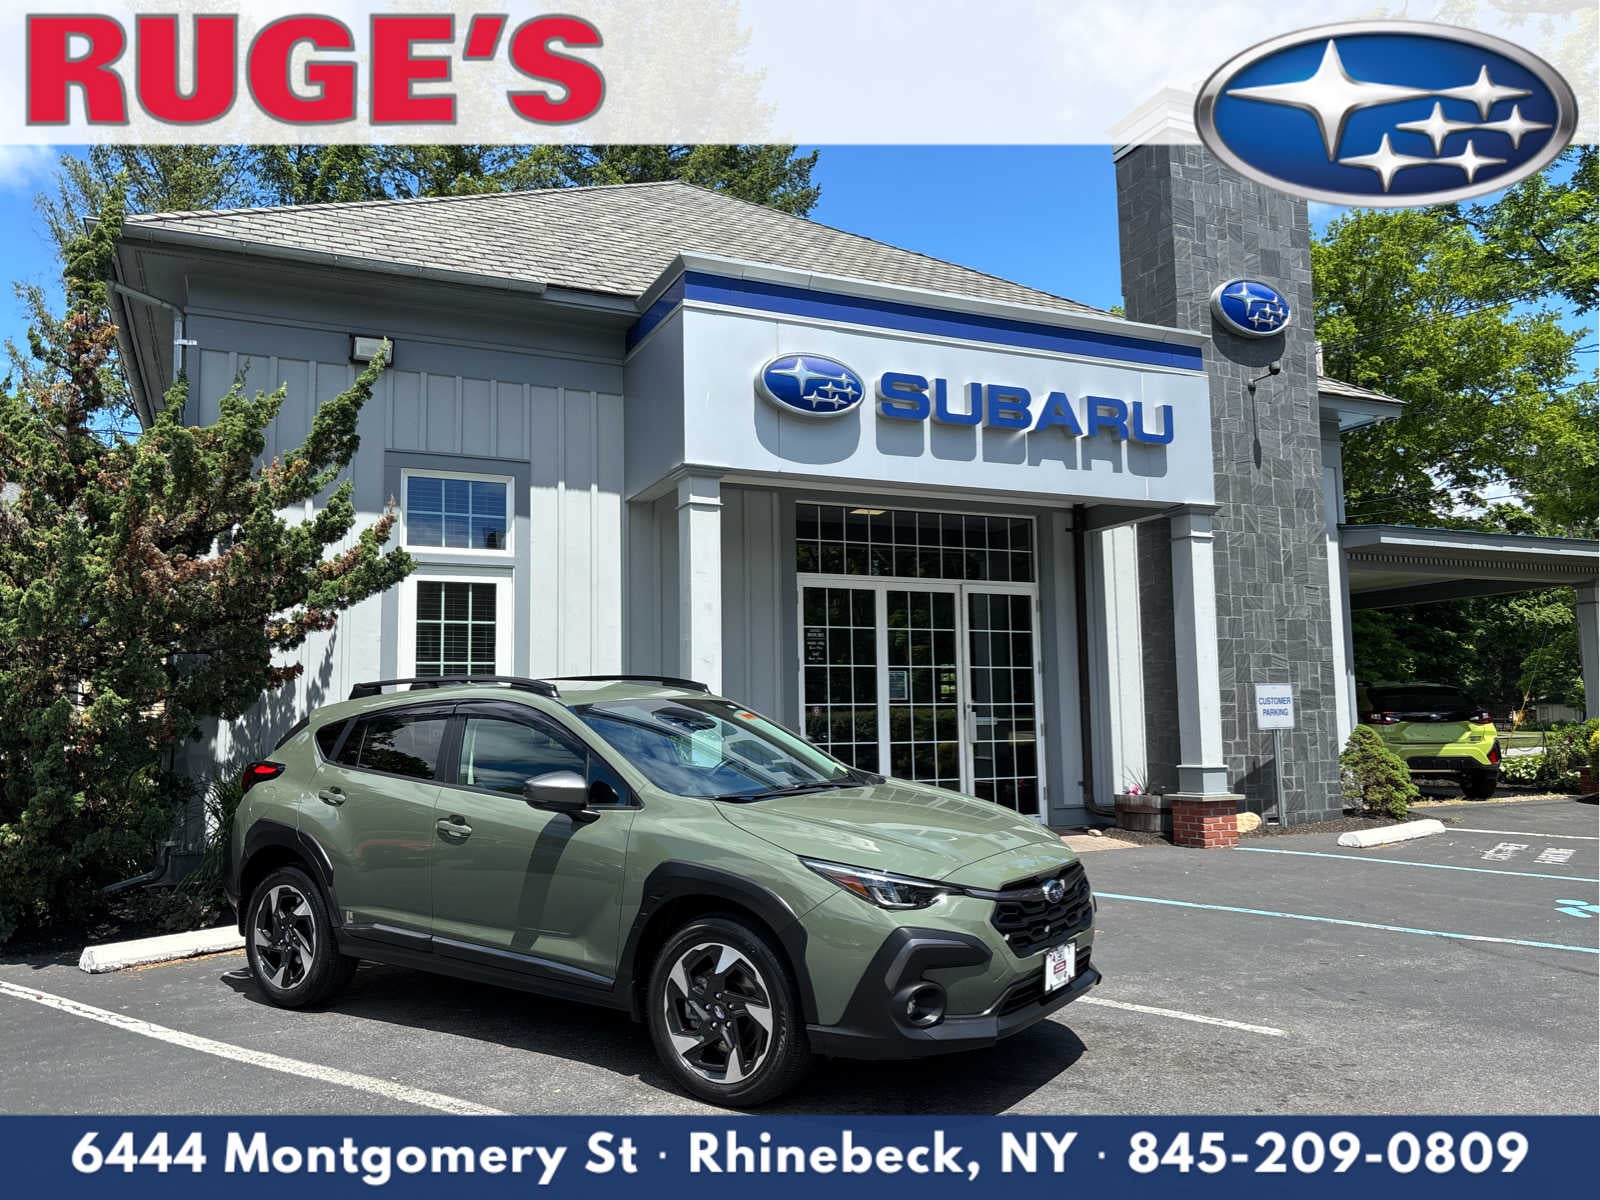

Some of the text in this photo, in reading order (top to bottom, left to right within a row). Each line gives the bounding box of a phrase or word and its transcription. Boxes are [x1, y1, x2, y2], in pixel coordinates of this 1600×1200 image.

[877, 371, 1174, 445] SUBARU
[1258, 696, 1291, 705] CUSTOMER
[1262, 708, 1289, 716] PARKING
